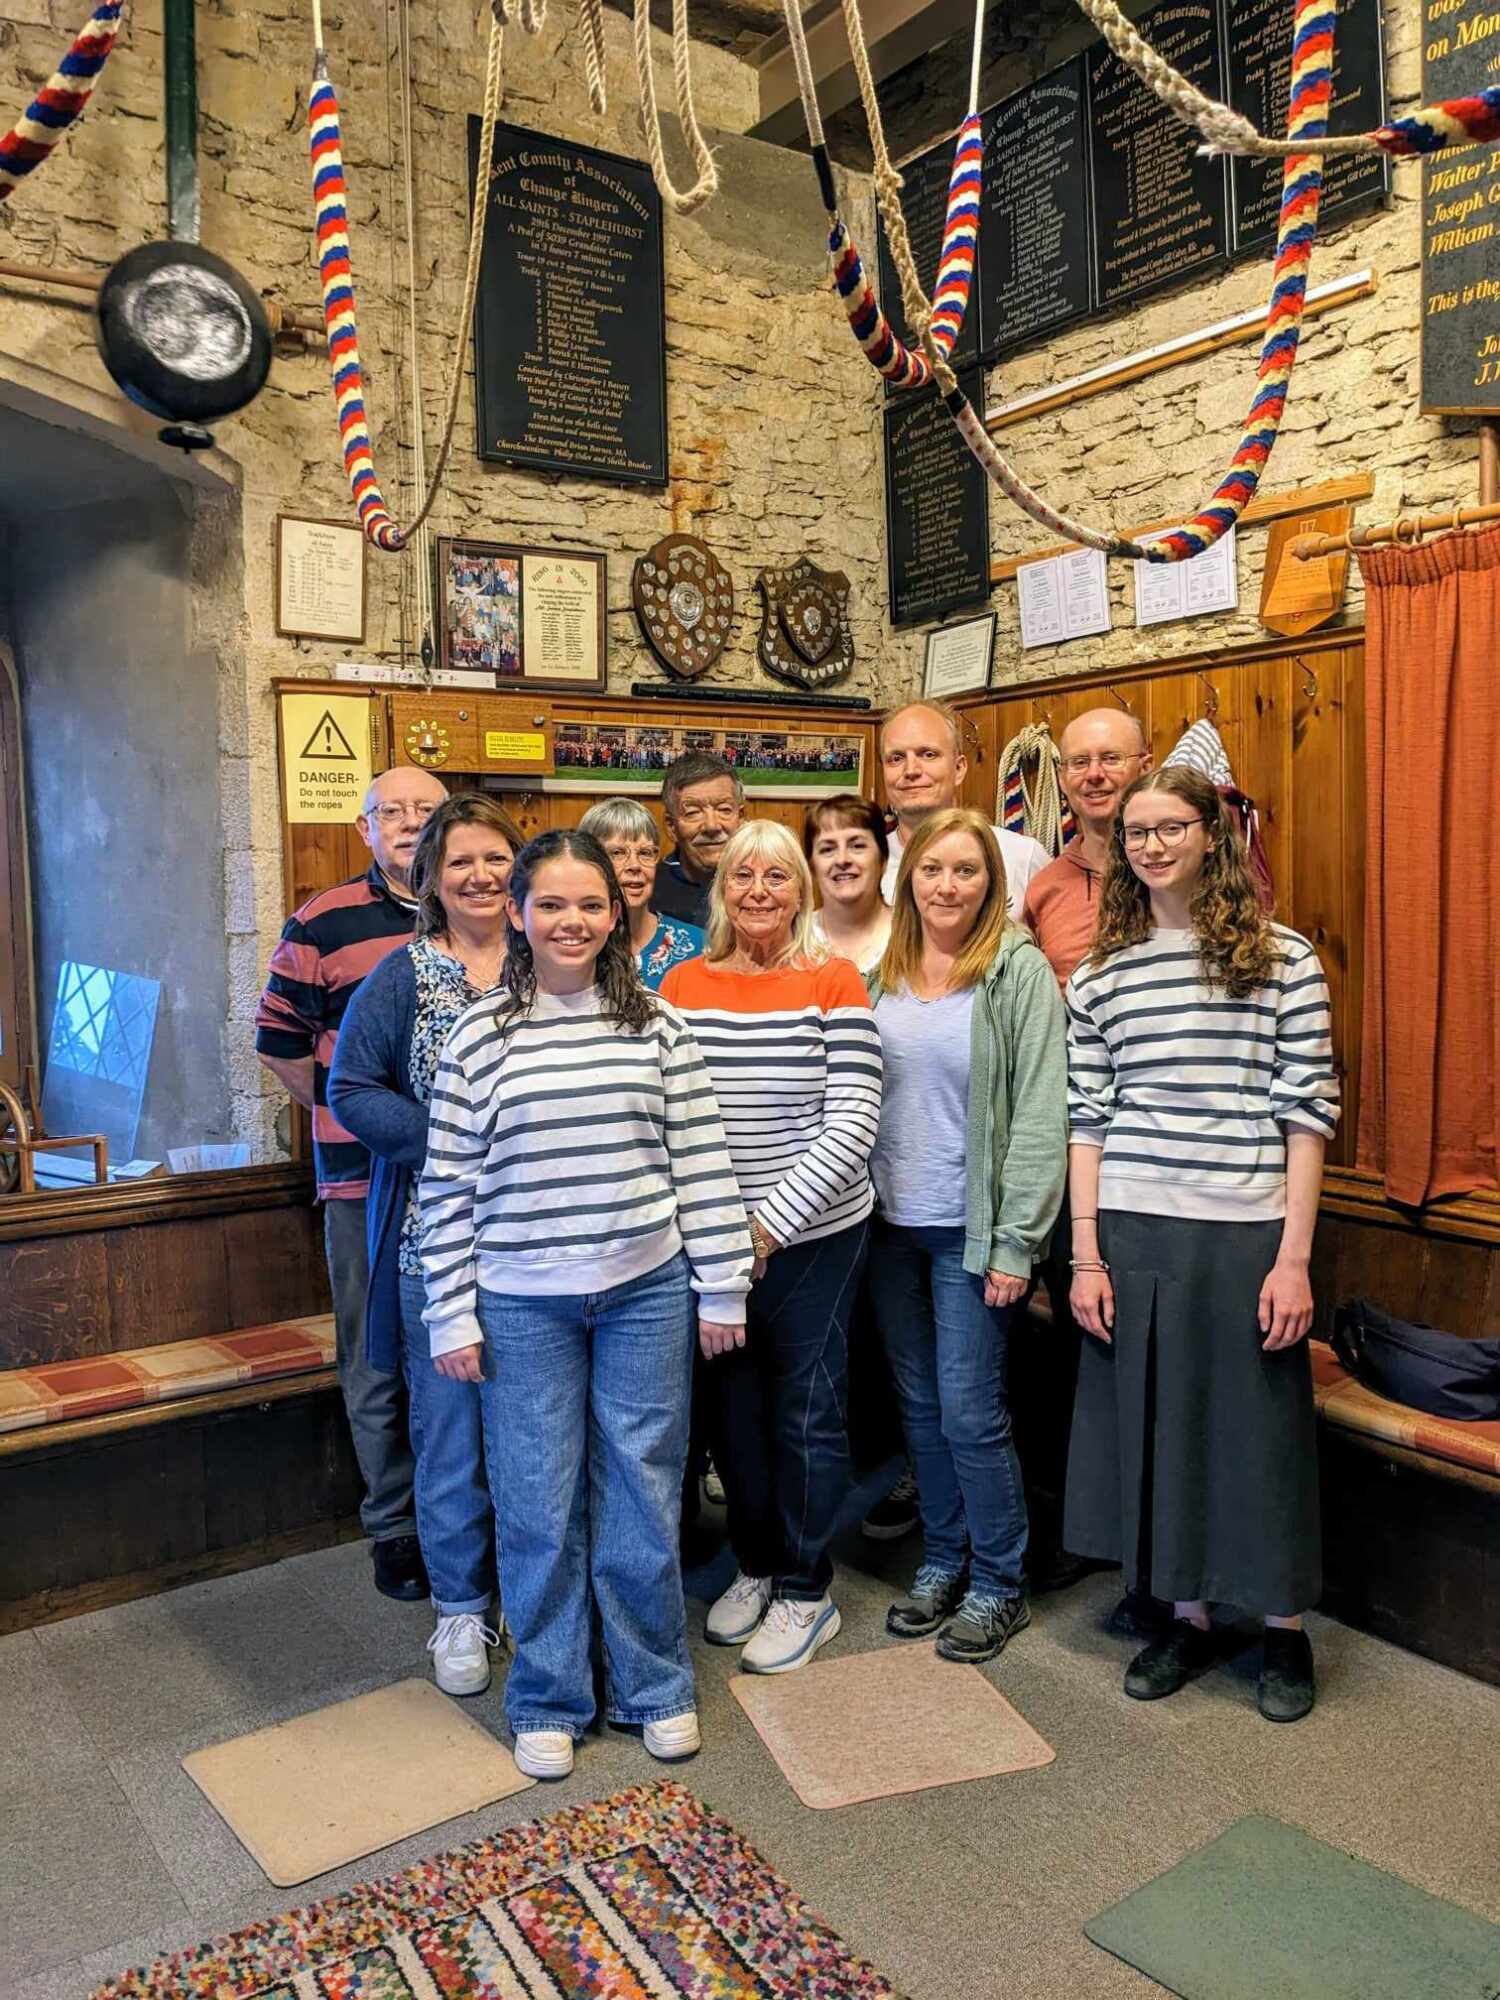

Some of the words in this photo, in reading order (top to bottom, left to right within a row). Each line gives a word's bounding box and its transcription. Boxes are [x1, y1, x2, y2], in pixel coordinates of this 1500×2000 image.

[1426, 37, 1449, 63] on
[519, 152, 571, 172] County
[576, 157, 650, 222] Association
[564, 176, 576, 188] of
[1428, 162, 1487, 197] Walter
[520, 176, 568, 202] Change
[570, 190, 619, 214] Ringers
[495, 193, 517, 207] ALL
[519, 199, 560, 218] SAINTS
[568, 212, 645, 239] STAPLEHURST
[1427, 191, 1485, 226] Joseph
[552, 221, 591, 238] December
[1428, 222, 1494, 257] William
[507, 221, 514, 233] A
[516, 223, 534, 236] Peal
[535, 228, 546, 241] of
[568, 238, 607, 254] Grandsire
[608, 248, 633, 261] Caters
[517, 251, 536, 262] Tenor
[549, 244, 572, 257] hours
[581, 254, 612, 267] minutes
[1427, 291, 1458, 316] This
[518, 365, 554, 378] Conducted
[554, 370, 564, 381] by
[517, 374, 532, 384] First
[533, 375, 549, 386] Peal
[594, 387, 609, 398] First
[610, 389, 625, 400] Peal
[527, 386, 543, 395] First
[544, 388, 559, 398] Peal
[559, 390, 568, 401] of
[528, 395, 548, 409] Rung
[548, 399, 559, 410] by
[589, 405, 604, 416] local
[605, 407, 622, 418] band
[533, 411, 549, 422] First
[550, 413, 565, 424] Peal
[575, 417, 586, 428] the
[587, 418, 601, 430] bells
[602, 422, 618, 432] since
[523, 433, 537, 443] The
[538, 436, 568, 449] Reverend
[569, 439, 588, 451] Brian
[528, 423, 564, 434] restoration
[565, 426, 578, 437] and
[578, 429, 623, 443] augmentation
[594, 452, 606, 463] and
[299, 771, 360, 784] DANGER-
[299, 788, 313, 797] Do
[315, 789, 330, 797] not
[332, 789, 358, 798] touch
[300, 800, 315, 808] the
[317, 801, 343, 810] ropes
